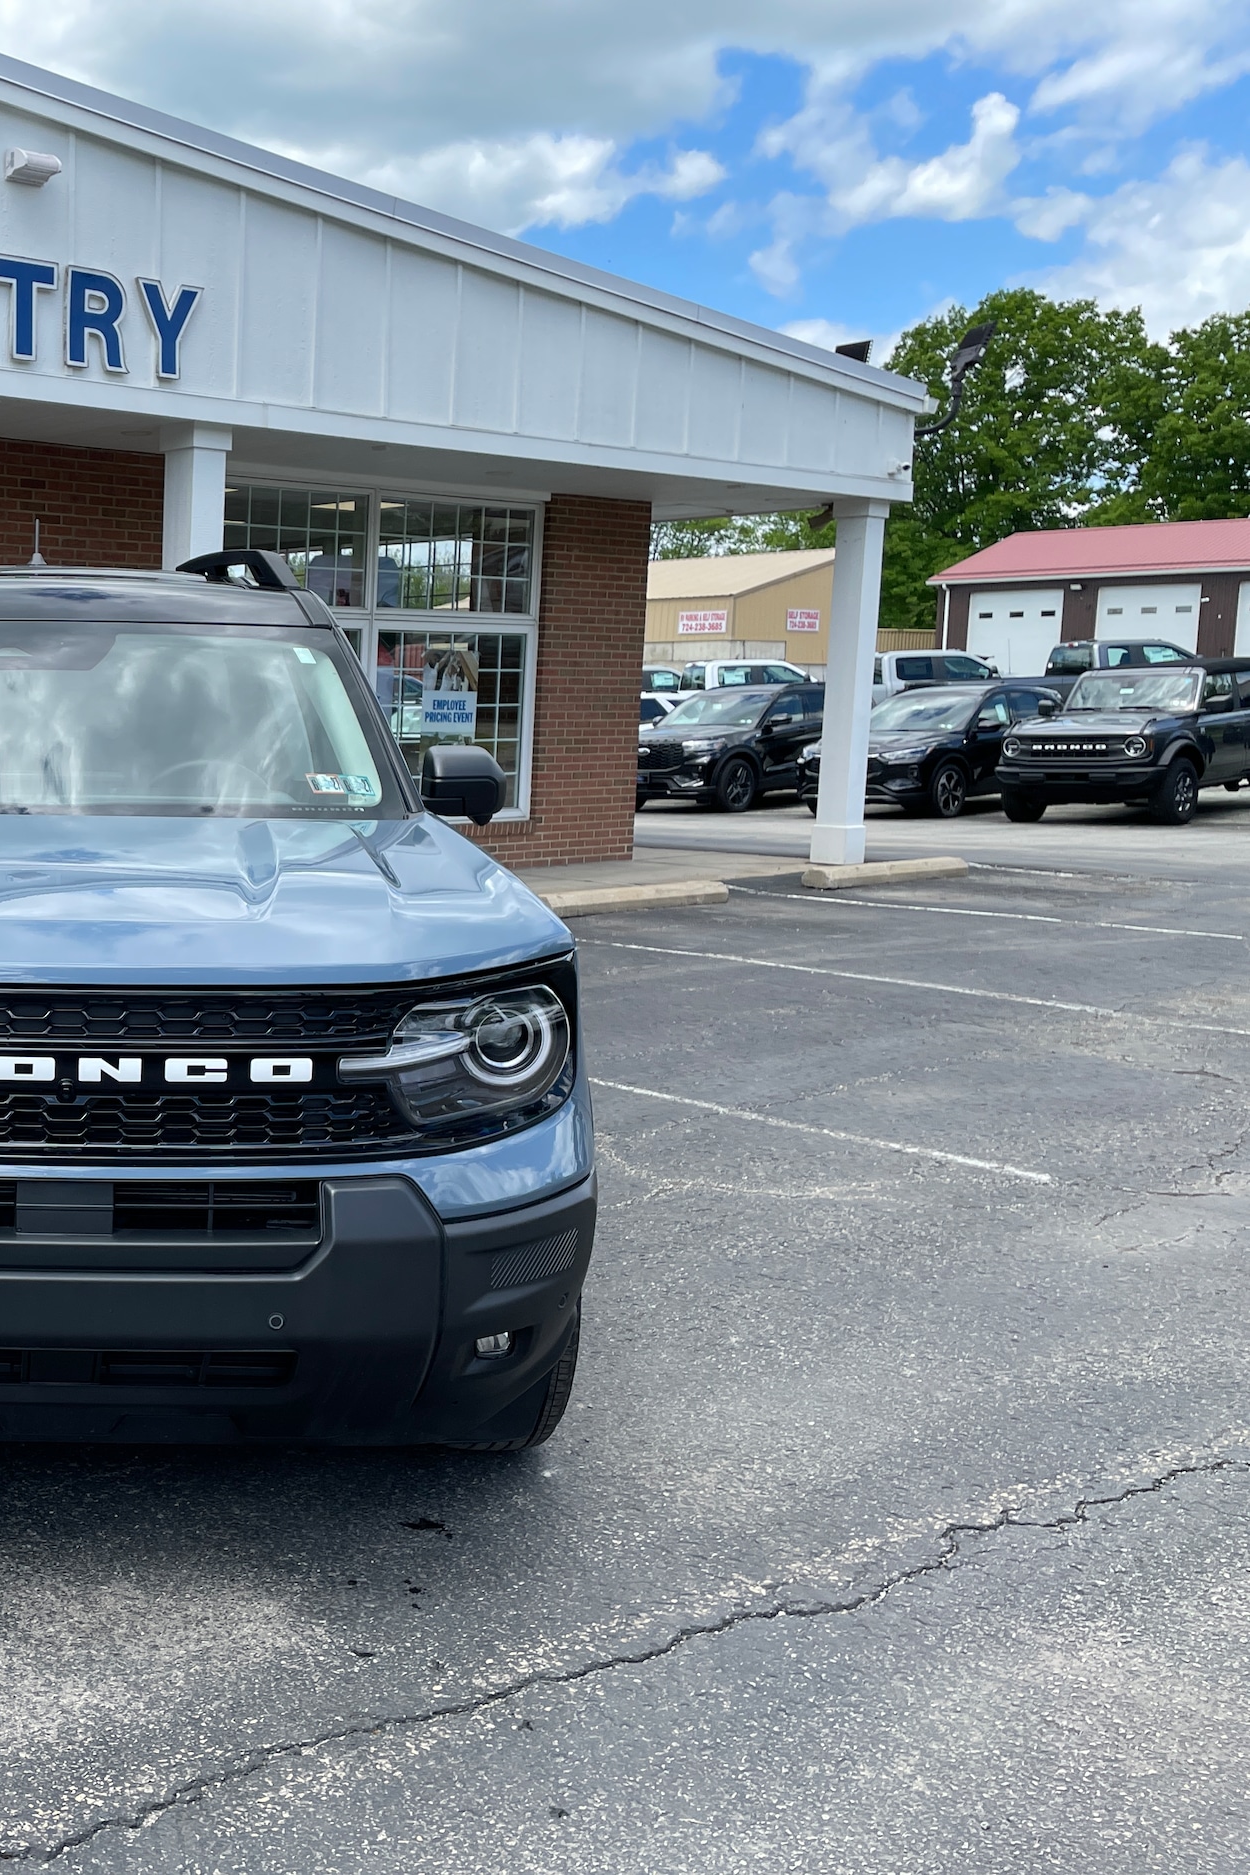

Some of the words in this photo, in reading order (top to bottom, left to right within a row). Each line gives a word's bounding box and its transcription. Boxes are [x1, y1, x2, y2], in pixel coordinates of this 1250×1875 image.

[432, 699, 467, 711] EMPLOYEE
[424, 711, 452, 723] PRICING
[453, 712, 474, 723] EVENT
